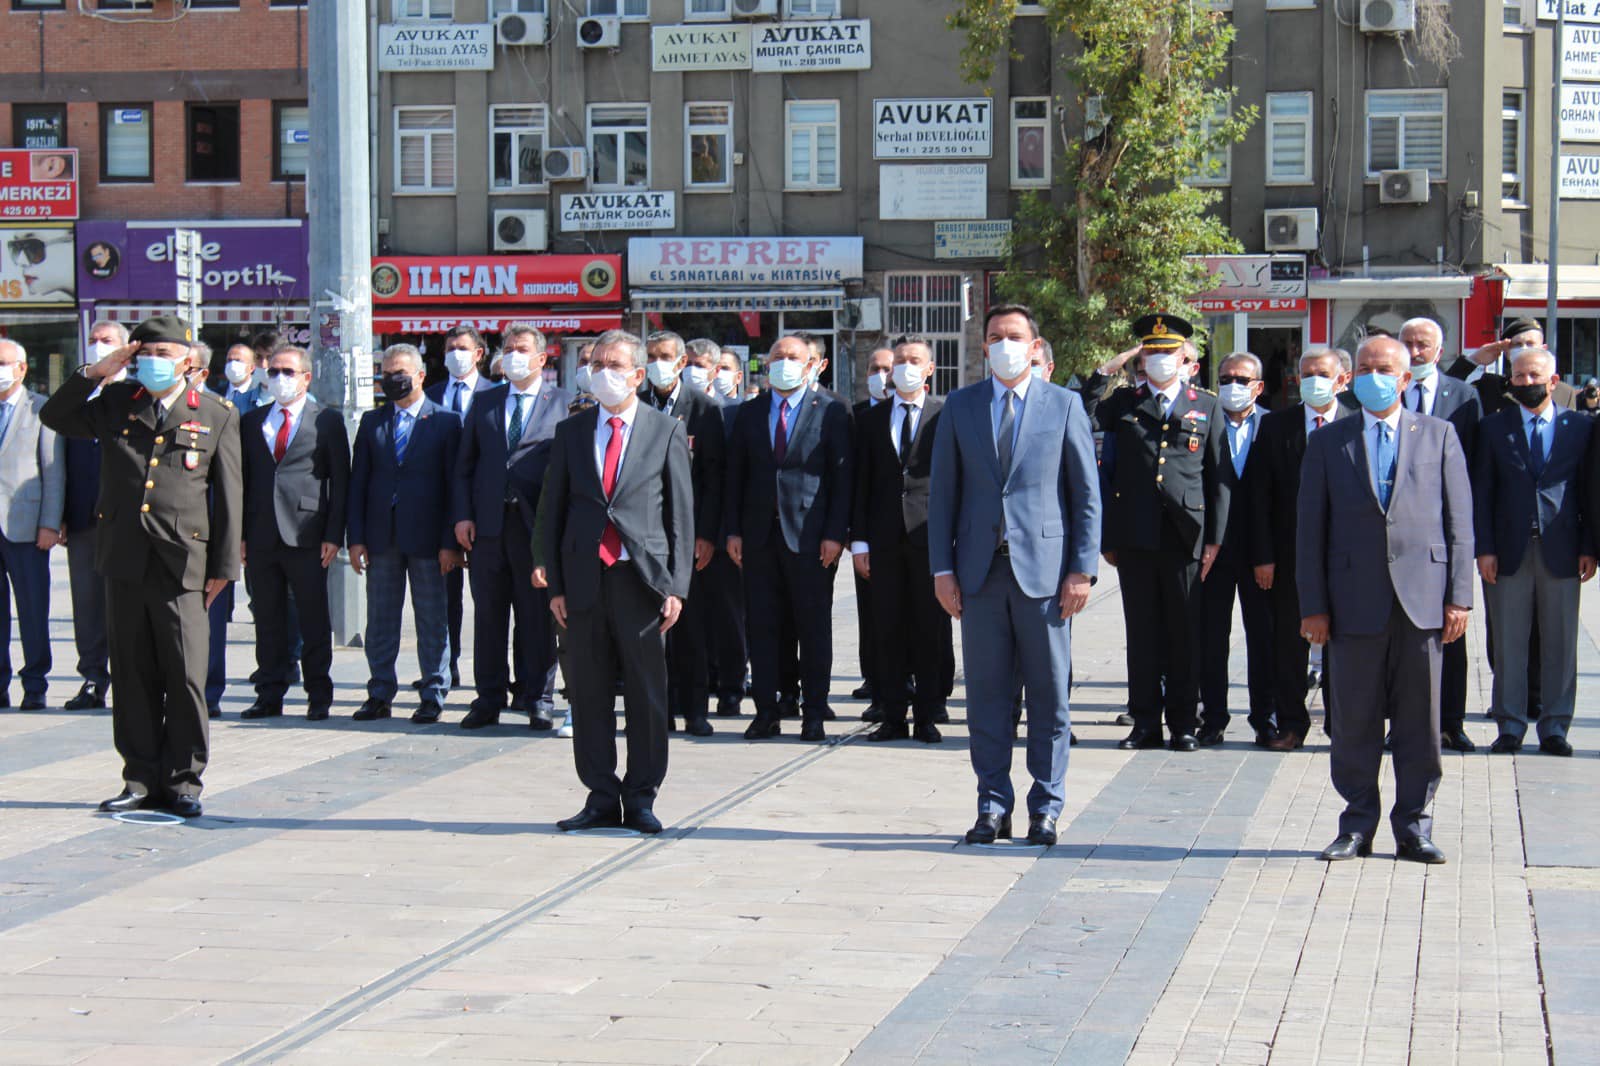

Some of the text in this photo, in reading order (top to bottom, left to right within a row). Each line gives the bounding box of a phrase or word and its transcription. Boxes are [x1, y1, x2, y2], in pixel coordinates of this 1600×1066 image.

[395, 29, 479, 41] AVUKAT
[664, 31, 741, 46] AVUKAT
[761, 25, 861, 43] AVUKAT
[1572, 30, 1600, 44] AVU
[385, 42, 488, 57] Ali İhsan AYAŞ
[756, 47, 800, 57] MURAT
[658, 52, 709, 64] AHMET
[1572, 91, 1600, 105] AVU
[878, 103, 989, 125] AVUKAT
[1561, 108, 1595, 122] ORHAN
[876, 128, 989, 143] Serhat DEVELİOĞLU
[1566, 158, 1600, 175] AVU
[1562, 178, 1599, 188] ERHAN
[570, 194, 665, 209] AVUKAT
[3, 206, 52, 215] 425 09 73
[659, 240, 830, 266] REFREF
[203, 264, 284, 291] optik
[408, 265, 518, 296] ILICAN
[650, 270, 665, 281] EL
[670, 270, 744, 282] SANATLARI
[771, 267, 841, 281] KIRTASİYE
